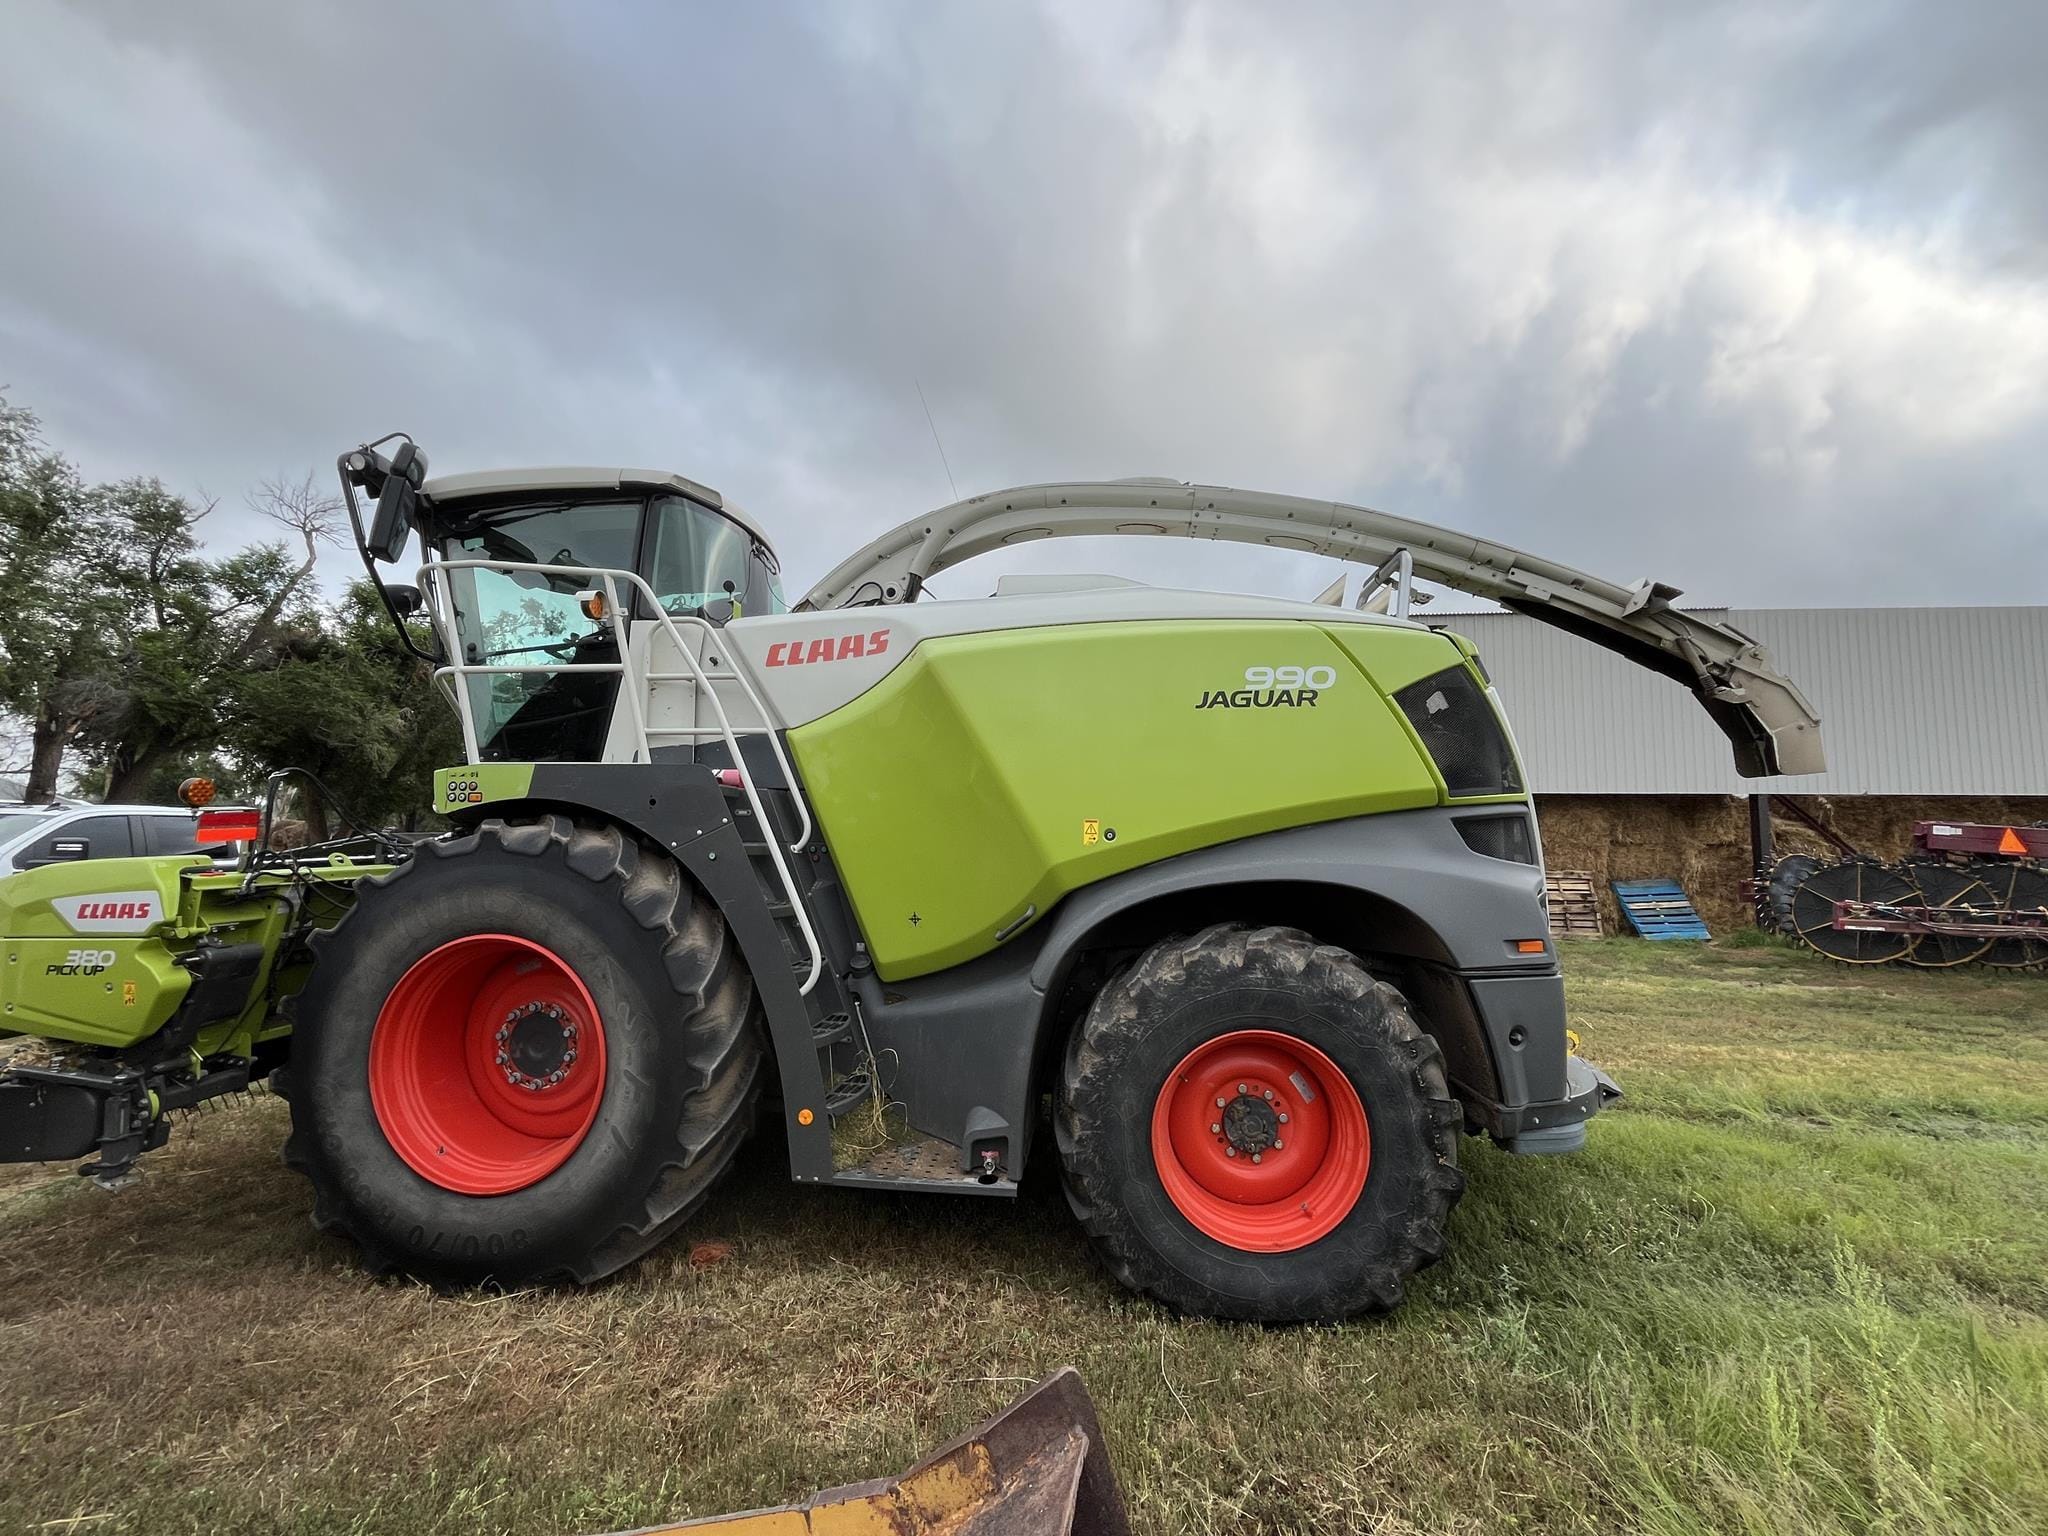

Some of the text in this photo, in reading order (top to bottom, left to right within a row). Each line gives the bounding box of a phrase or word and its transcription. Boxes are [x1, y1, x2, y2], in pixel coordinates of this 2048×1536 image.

[765, 629, 891, 668] CLAAS
[1244, 665, 1337, 690] 990
[1195, 689, 1319, 709] JAGUAR
[77, 903, 151, 920] CLAAS
[64, 949, 116, 967] 380
[45, 964, 105, 976] PICK UP
